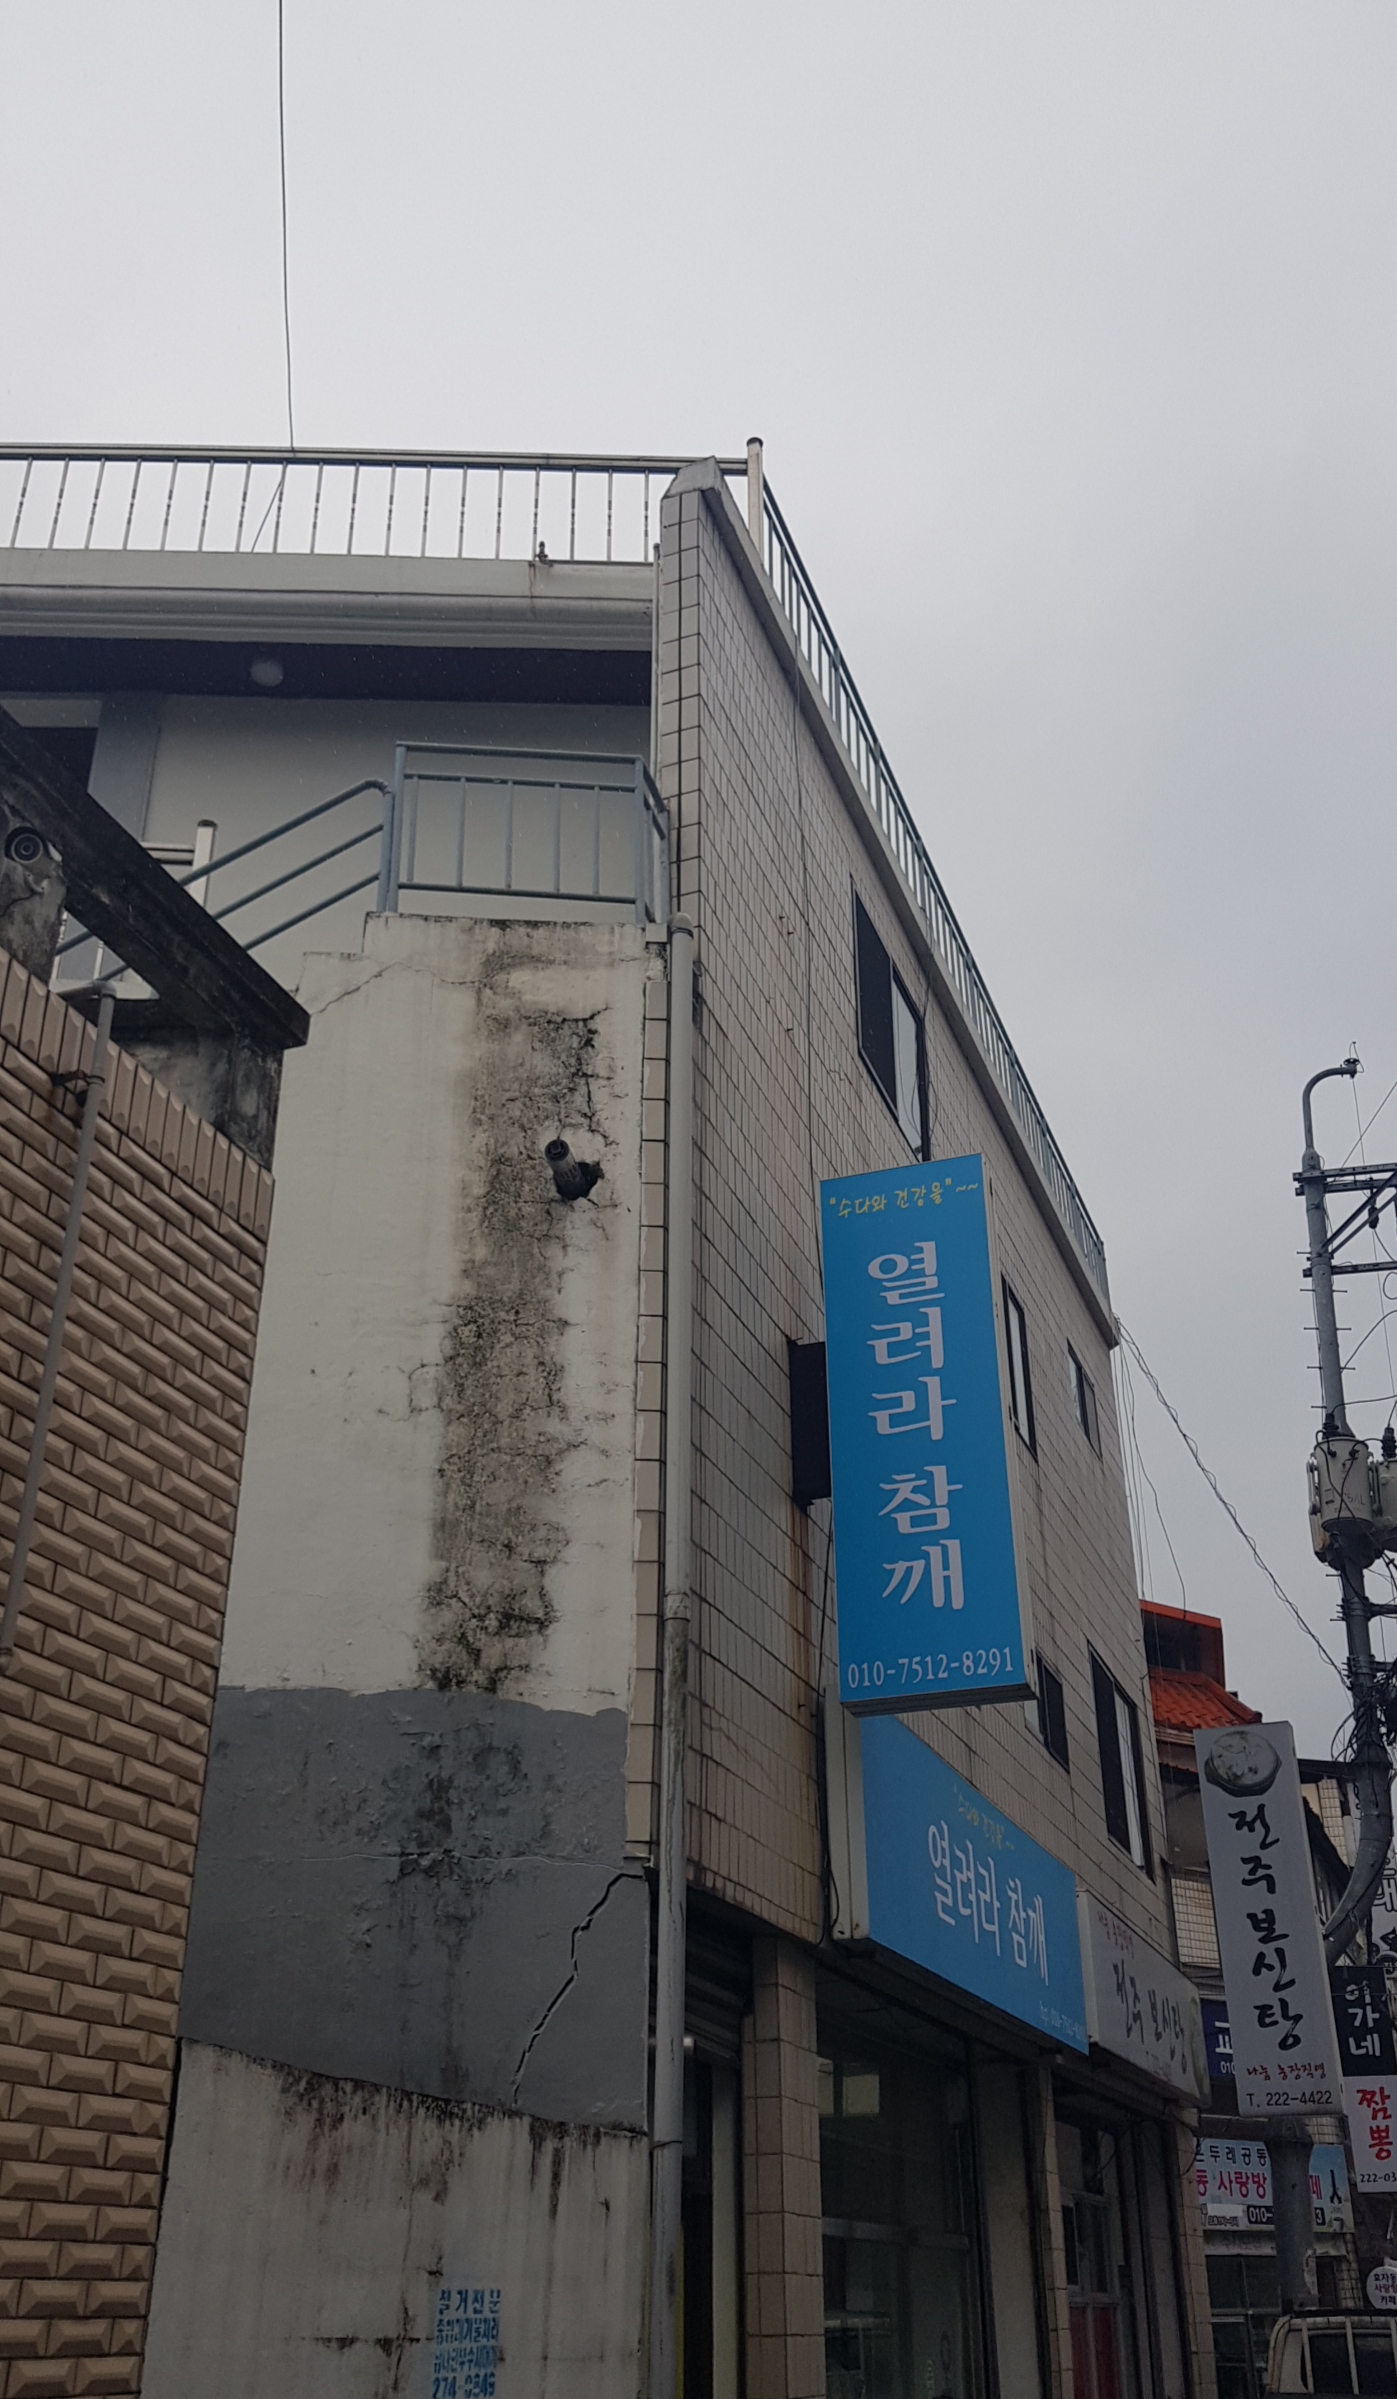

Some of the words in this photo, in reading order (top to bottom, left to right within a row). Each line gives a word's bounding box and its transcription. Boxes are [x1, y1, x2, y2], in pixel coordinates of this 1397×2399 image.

[867, 1241, 957, 1440] 열려라
[878, 1465, 965, 1610] 참깨
[848, 1646, 1014, 1688] 010-7512-8291
[928, 1820, 1000, 1957] 열려라
[1006, 1877, 1048, 1986] 참깨
[1266, 2090, 1333, 2107] 222-4422
[1356, 2086, 1394, 2160] 짬뽕
[1218, 2170, 1267, 2199] 사랑방
